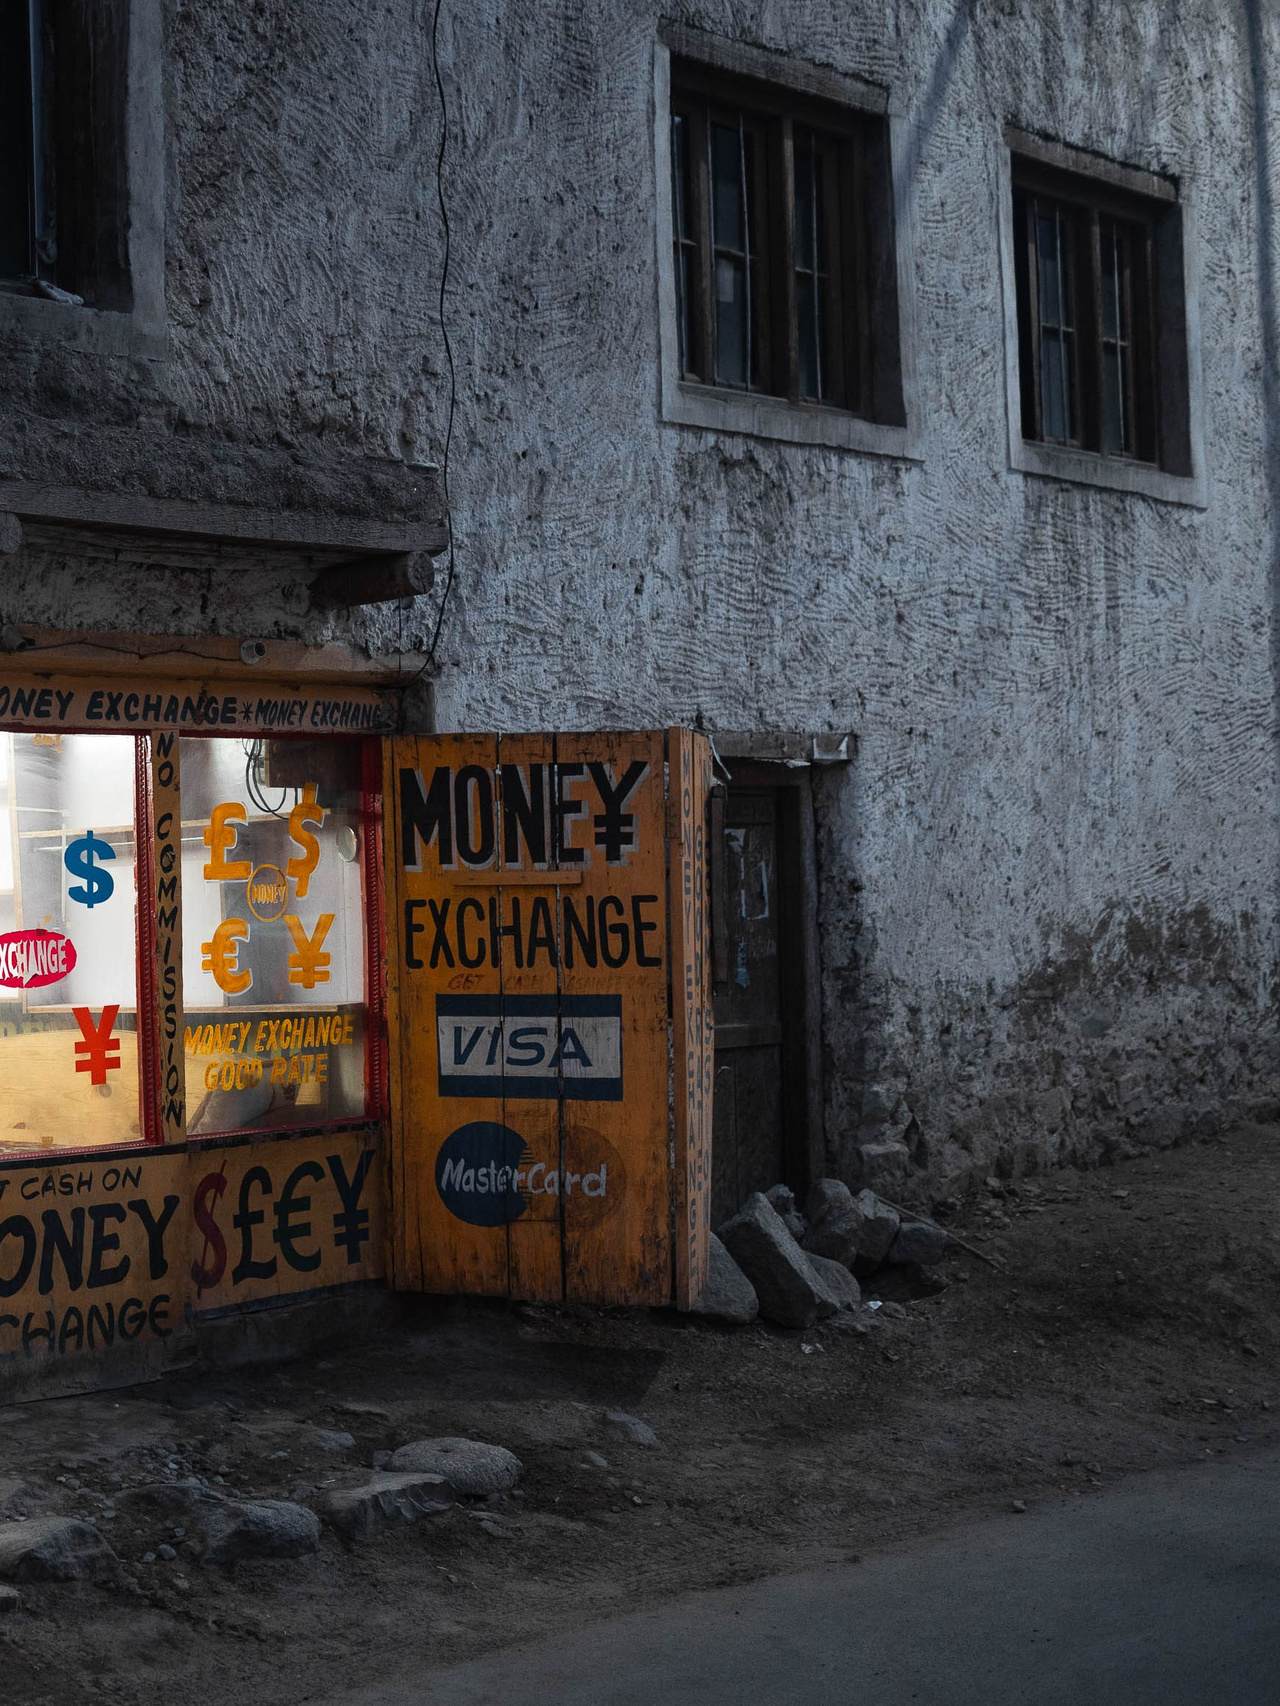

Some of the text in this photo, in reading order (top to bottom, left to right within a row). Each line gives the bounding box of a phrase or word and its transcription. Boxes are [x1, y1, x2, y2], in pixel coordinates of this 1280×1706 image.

[86, 690, 237, 725] EXCHANGE
[254, 698, 308, 727] MONEY
[286, 782, 325, 898] $
[63, 830, 117, 909] $
[251, 882, 287, 905] MONEY
[155, 731, 183, 1129] NO COMMISSION
[404, 894, 663, 970] EXCHANGE
[201, 917, 253, 995] €
[71, 1004, 121, 1086] ¥
[184, 1013, 355, 1058] MONEY EXCHANGE
[452, 1025, 594, 1068] VISA
[204, 1052, 329, 1093] GOOD RATE
[20, 1168, 93, 1200] CASH
[102, 1165, 142, 1191] ON
[441, 1156, 608, 1199] MasterCard
